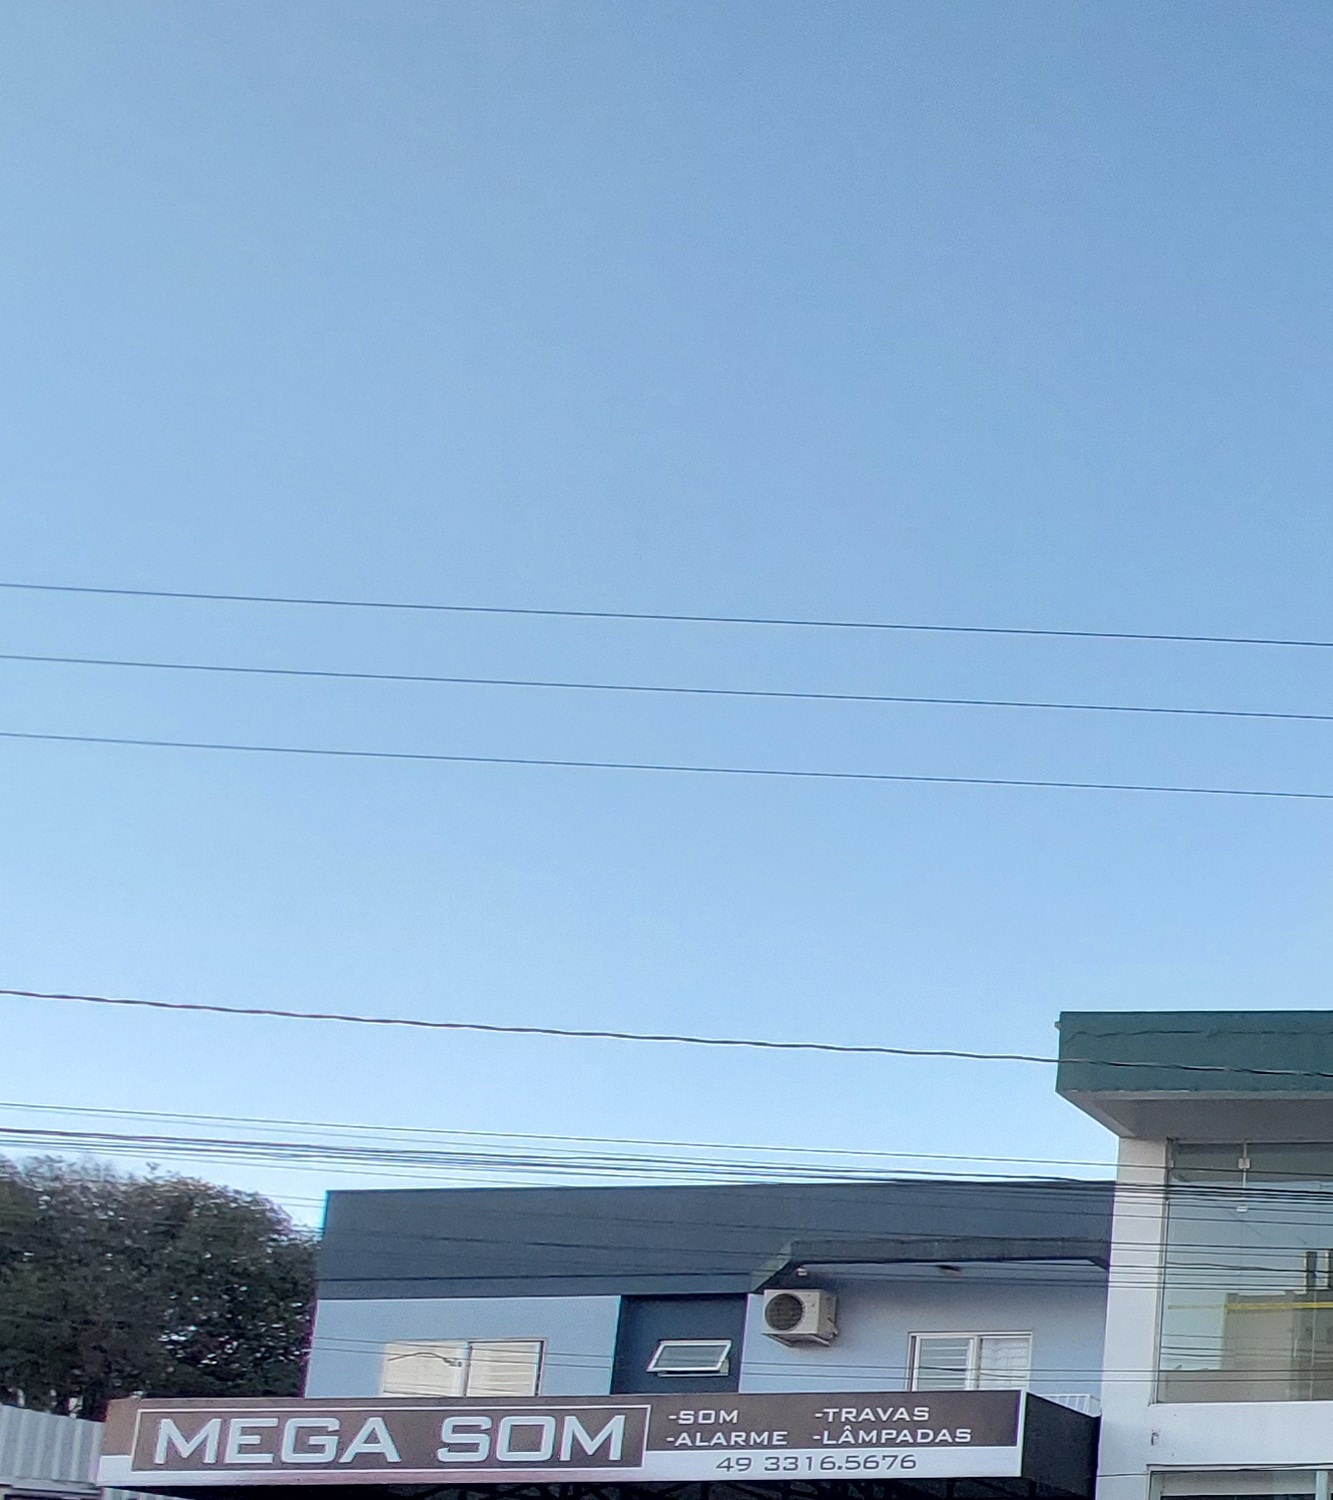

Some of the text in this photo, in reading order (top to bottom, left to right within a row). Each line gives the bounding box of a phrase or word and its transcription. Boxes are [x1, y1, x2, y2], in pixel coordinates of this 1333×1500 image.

[153, 1415, 626, 1464] MEGA SOM
[716, 1454, 918, 1473] 49 3316.5676
